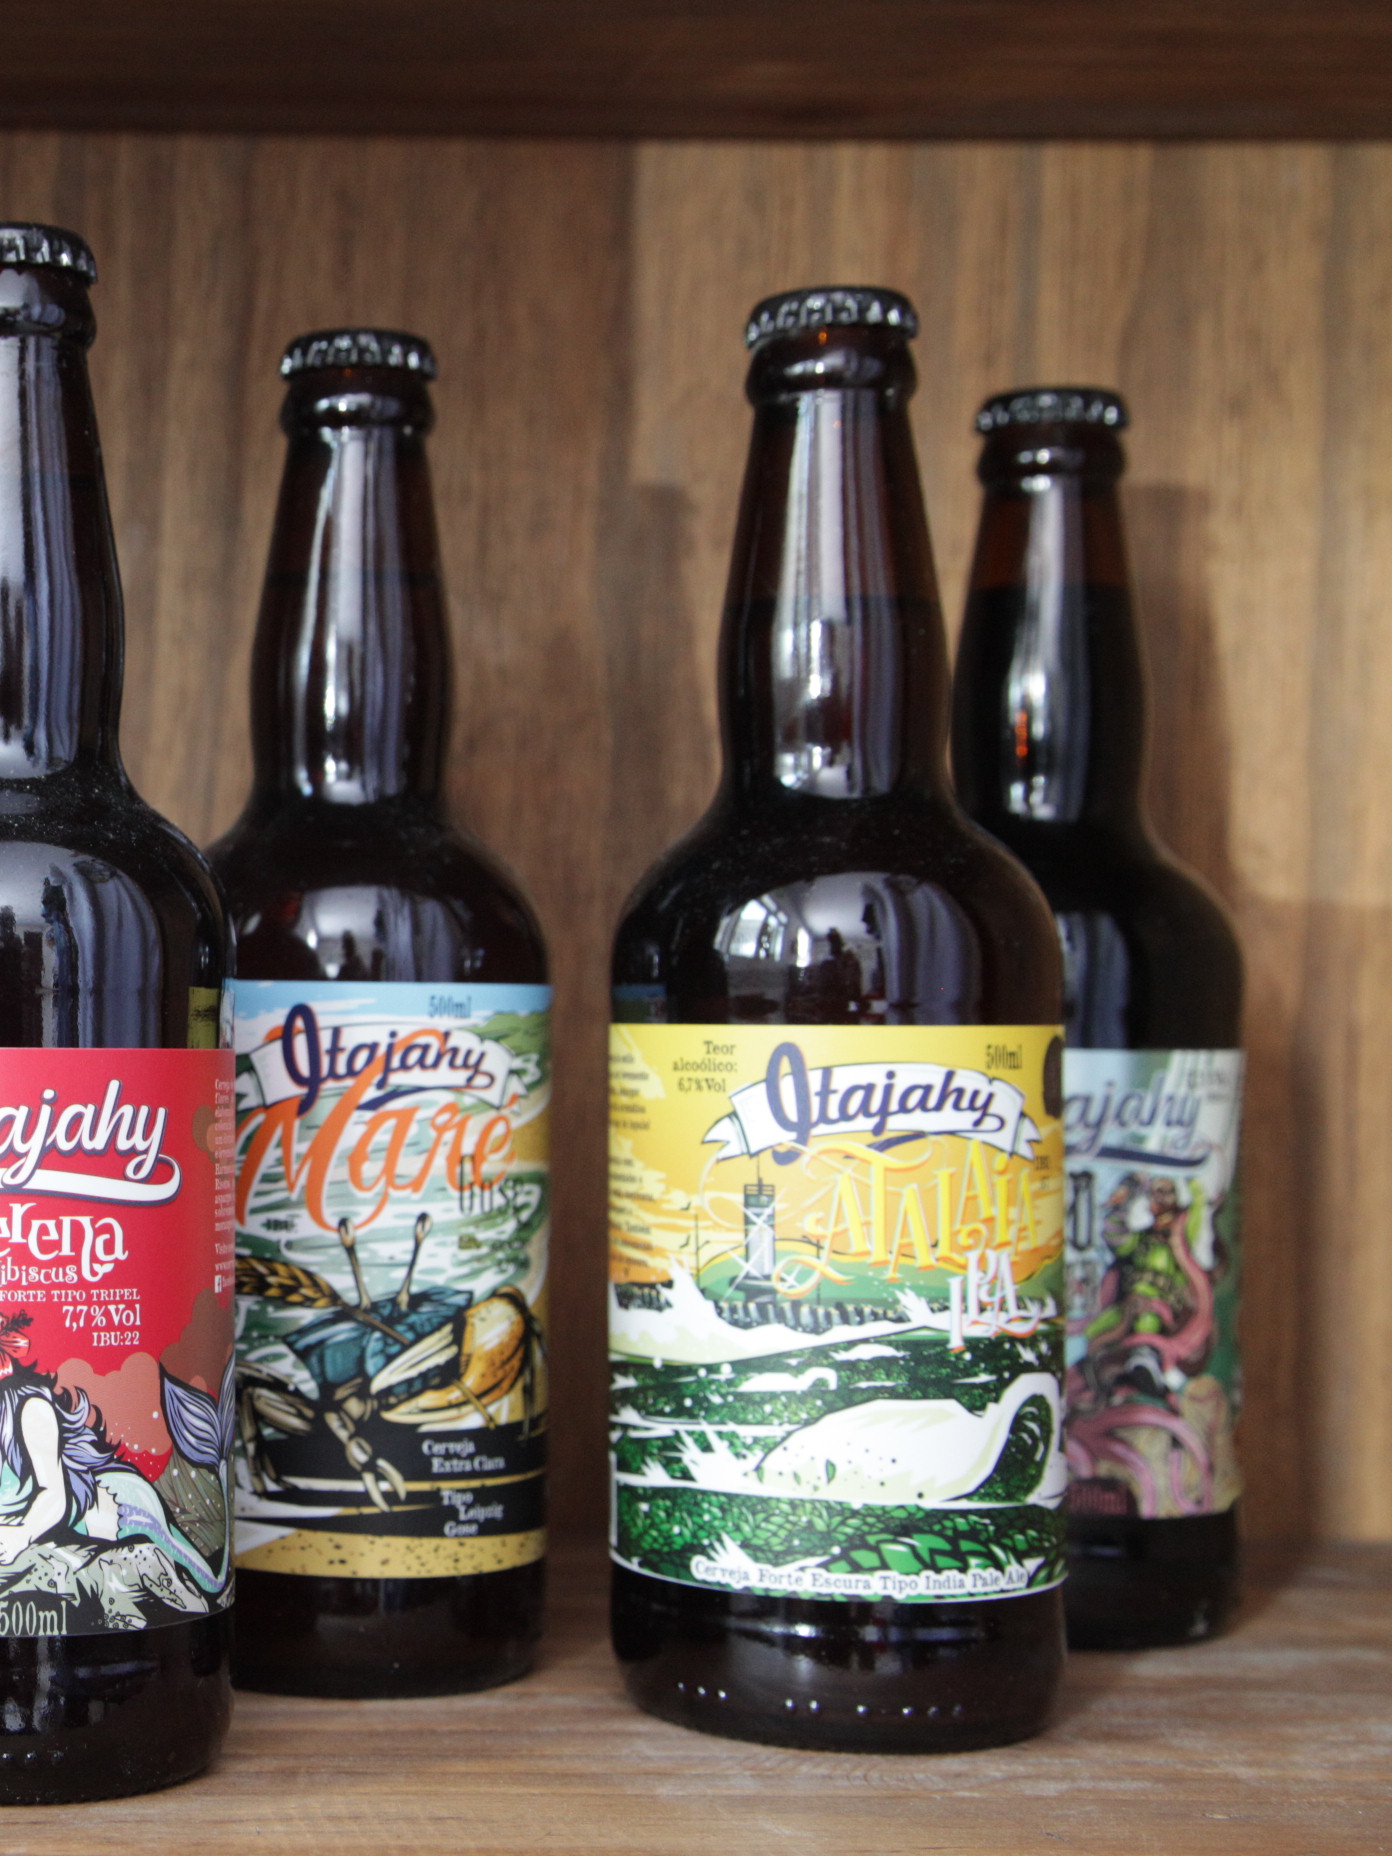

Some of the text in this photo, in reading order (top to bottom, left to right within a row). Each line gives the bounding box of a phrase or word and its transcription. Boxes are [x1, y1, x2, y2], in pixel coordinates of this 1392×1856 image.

[428, 995, 472, 1019] 500ml
[281, 1003, 496, 1118] Itajahy
[704, 1040, 737, 1055] Teor
[985, 1043, 1023, 1071] 500ml
[673, 1056, 738, 1073] alcoólico:
[765, 1041, 1005, 1166] Itajahy
[51, 1288, 87, 1302] TIPO
[90, 1288, 141, 1301] TRIPEL
[946, 1250, 1042, 1353] IPA
[92, 1331, 140, 1347] IBU:22
[694, 1559, 1028, 1596] Cerveja Forte Escura Tipo India Pale Ale
